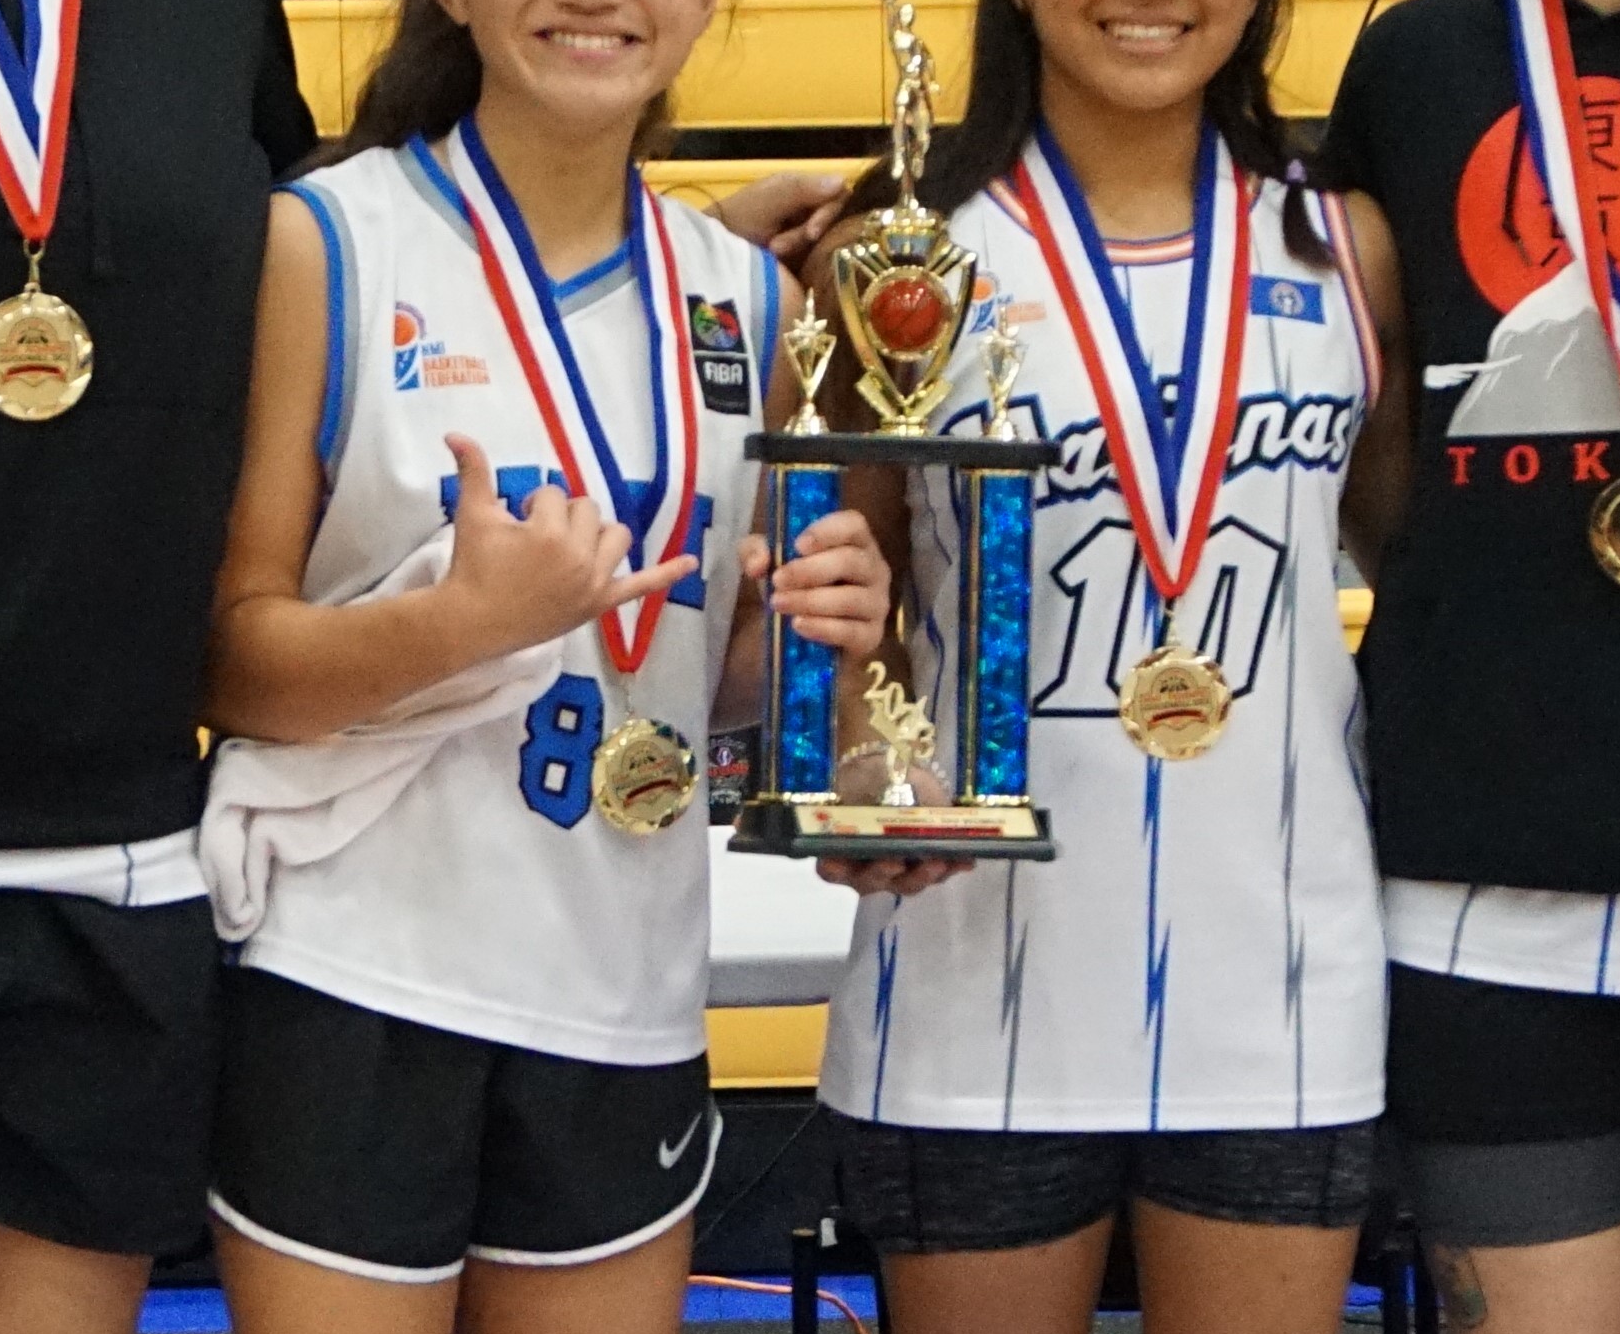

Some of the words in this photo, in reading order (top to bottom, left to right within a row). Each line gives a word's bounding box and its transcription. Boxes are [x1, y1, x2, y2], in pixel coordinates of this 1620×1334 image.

[702, 360, 744, 386] FIBA
[1031, 515, 1288, 719] 10
[517, 671, 604, 831] 8
